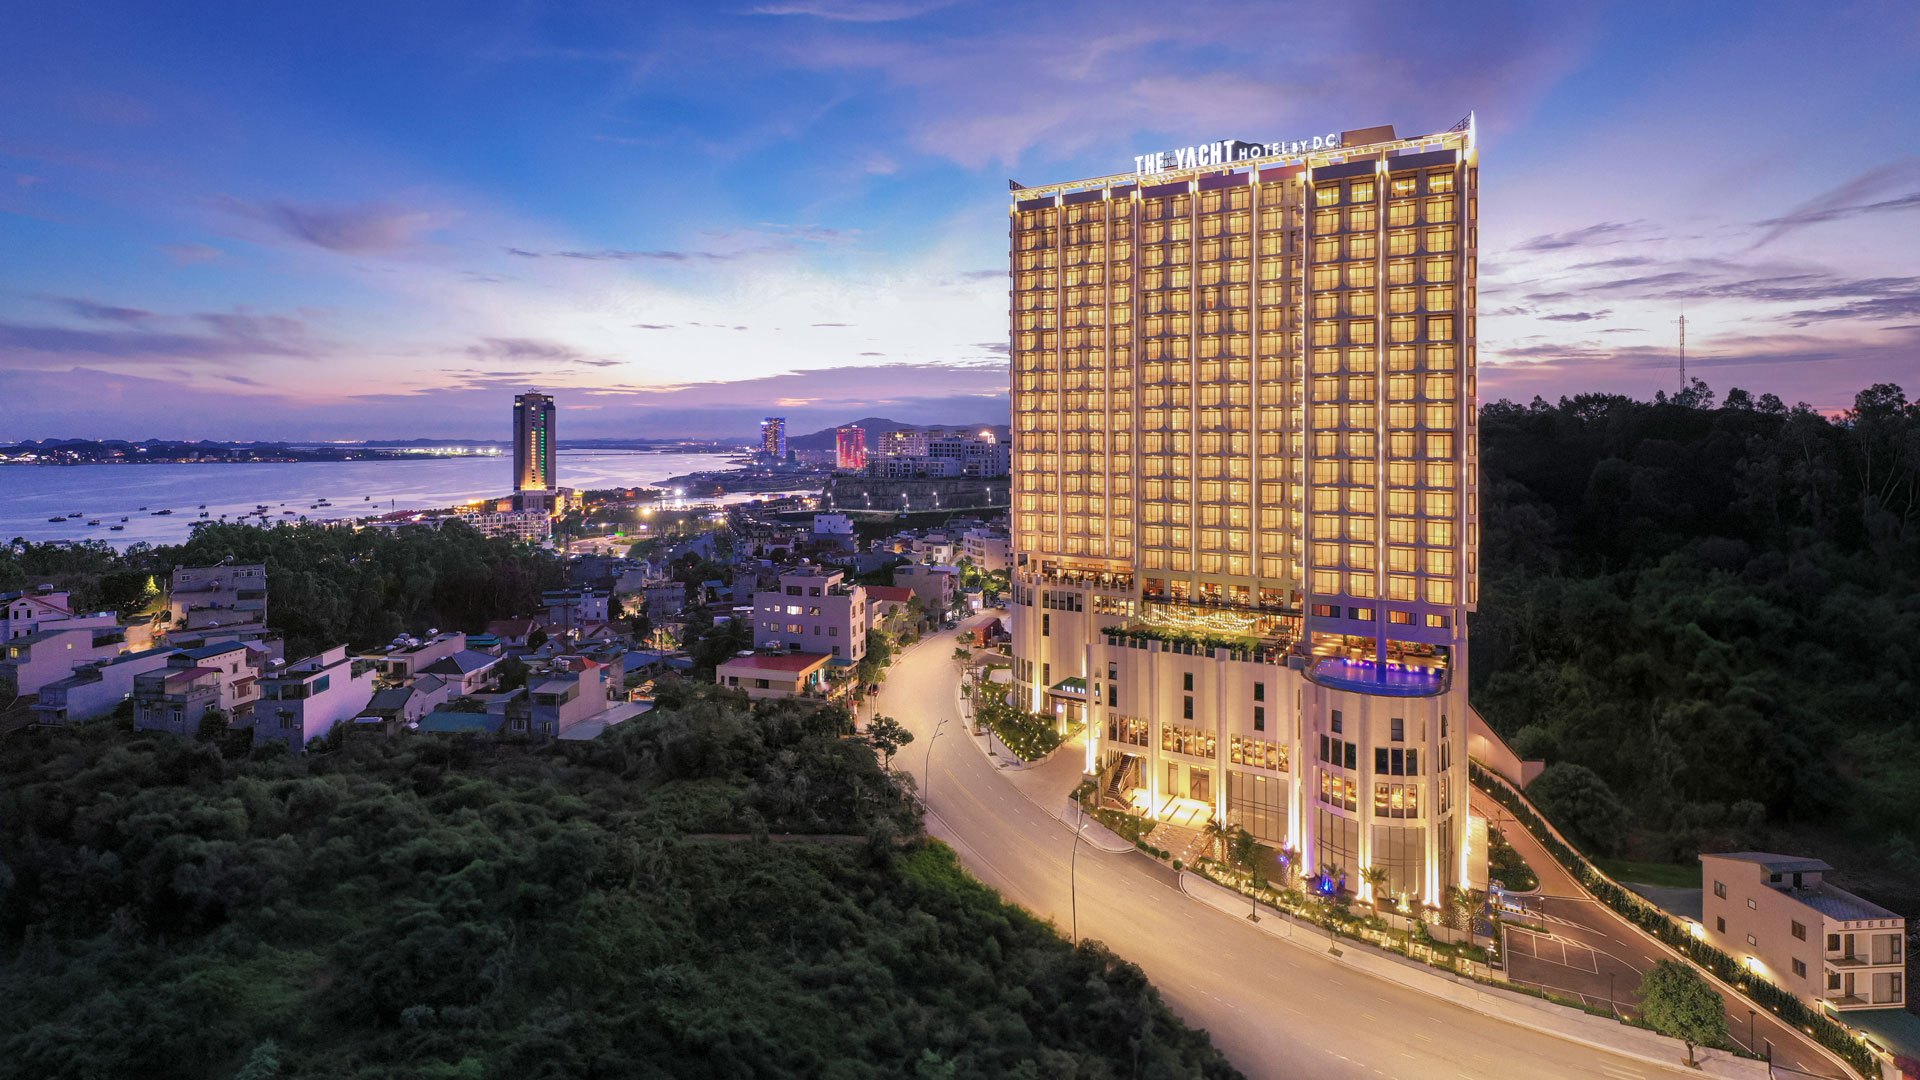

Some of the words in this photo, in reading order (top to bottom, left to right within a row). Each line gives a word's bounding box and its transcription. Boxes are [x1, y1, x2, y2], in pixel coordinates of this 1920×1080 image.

[1134, 153, 1164, 176] THE
[1175, 140, 1235, 169] YACHT
[1239, 142, 1287, 160] HOTEL
[1292, 140, 1307, 153] BY
